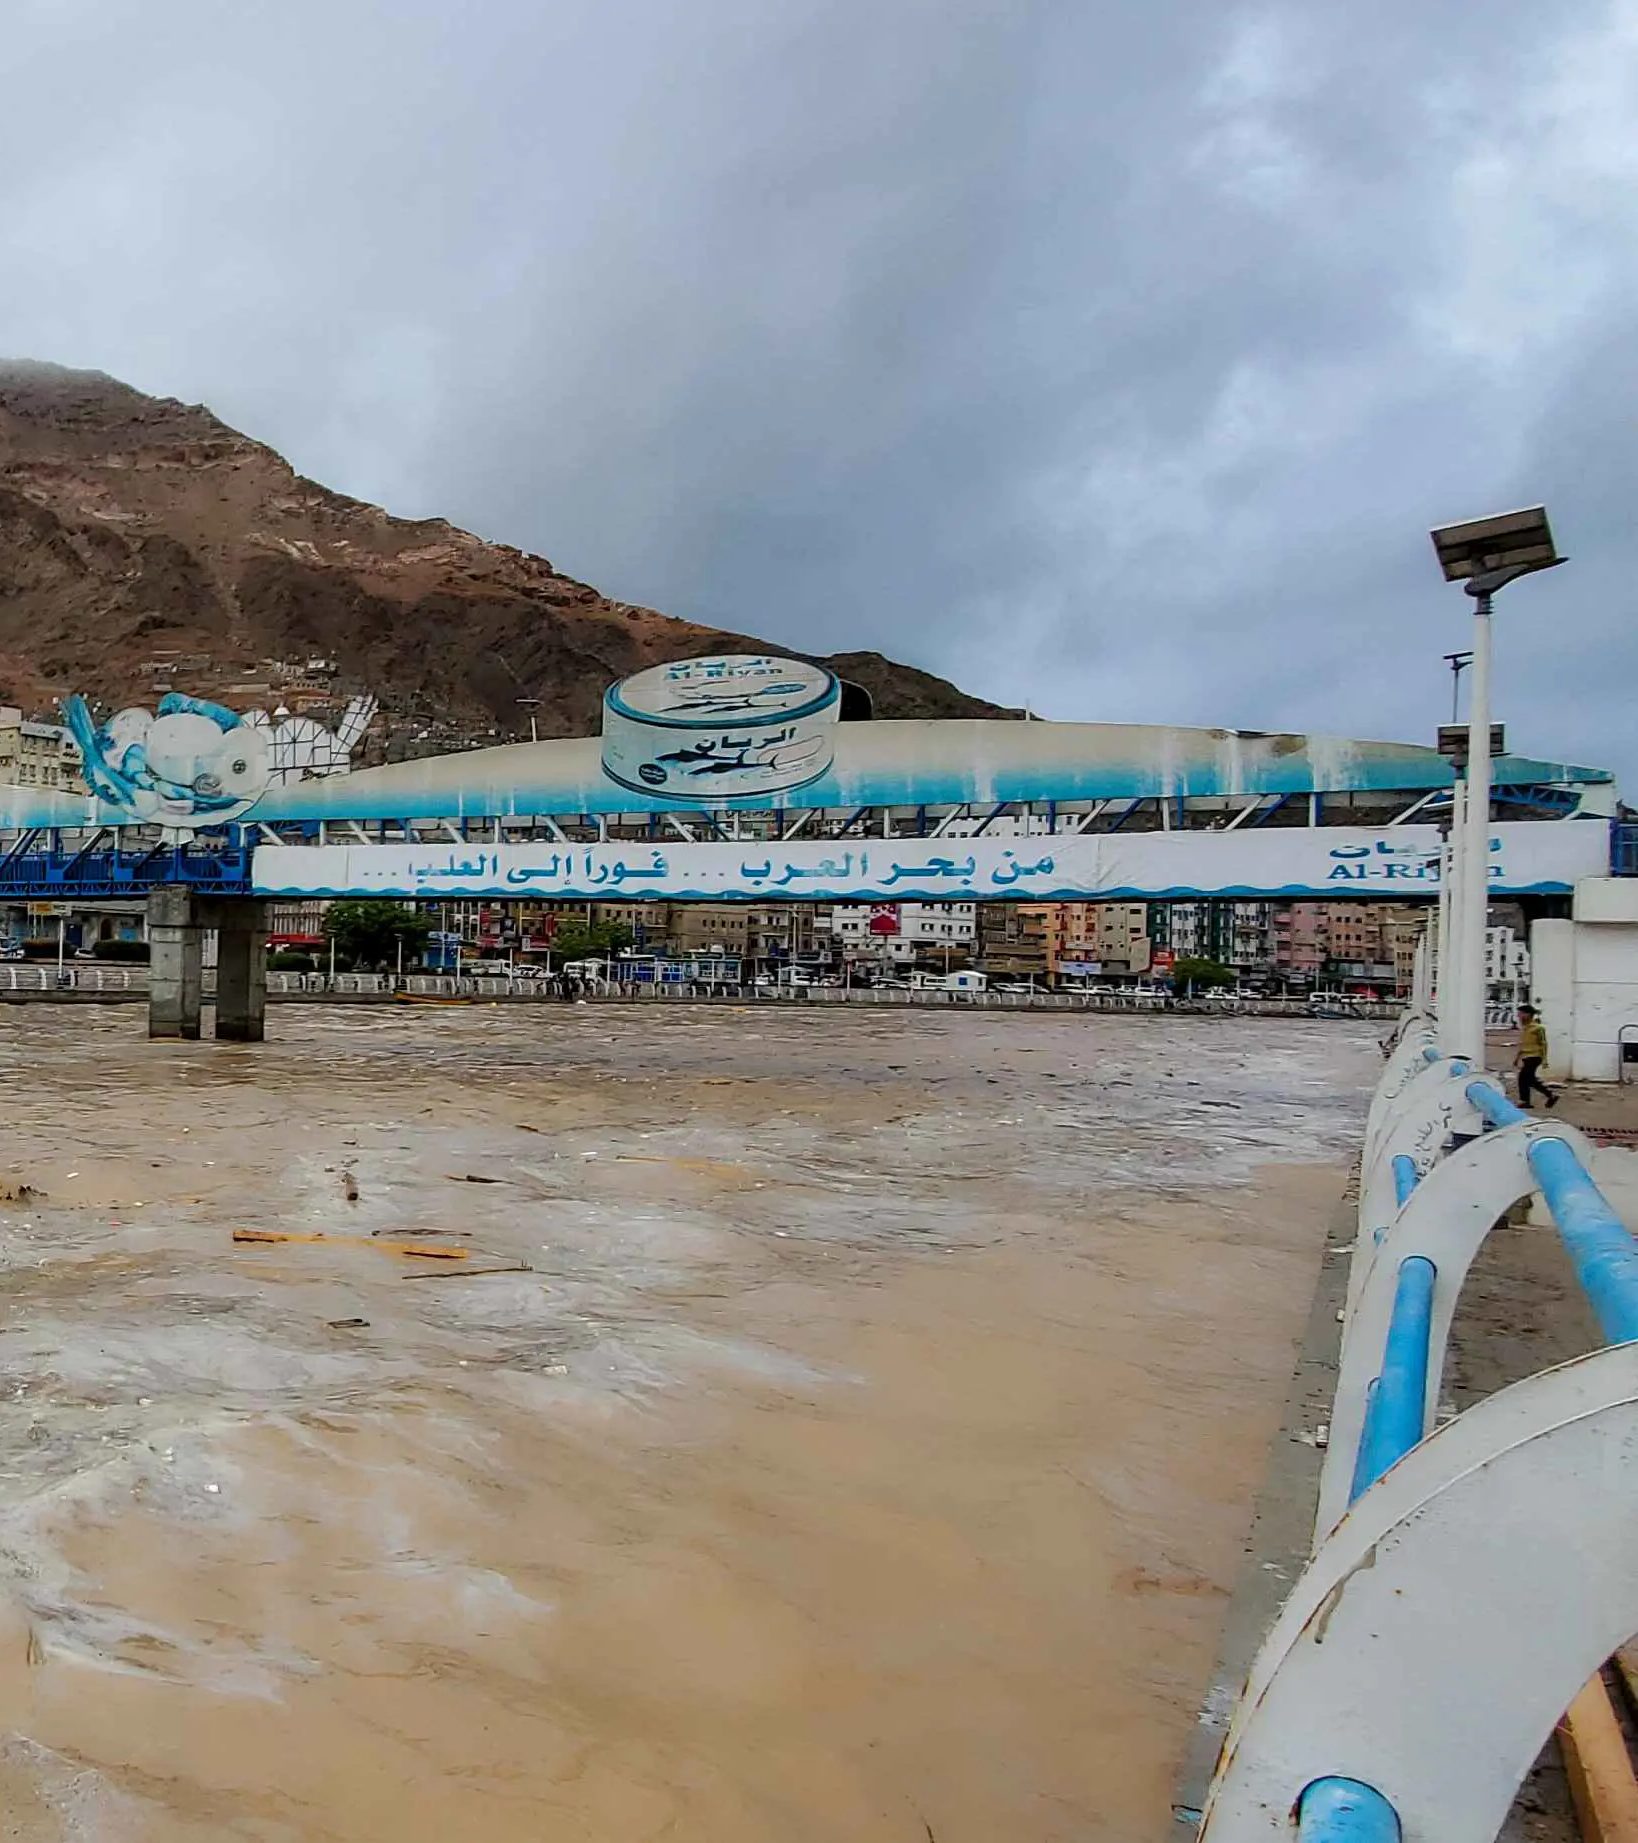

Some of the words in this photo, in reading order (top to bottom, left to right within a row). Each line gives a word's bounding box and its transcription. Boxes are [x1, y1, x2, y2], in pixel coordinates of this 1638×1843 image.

[695, 727, 798, 752] الريان
[506, 853, 573, 885] إلى
[585, 847, 669, 885] فوراً
[740, 852, 869, 886] العرب
[876, 856, 976, 885] بحر
[991, 850, 1054, 884] من
